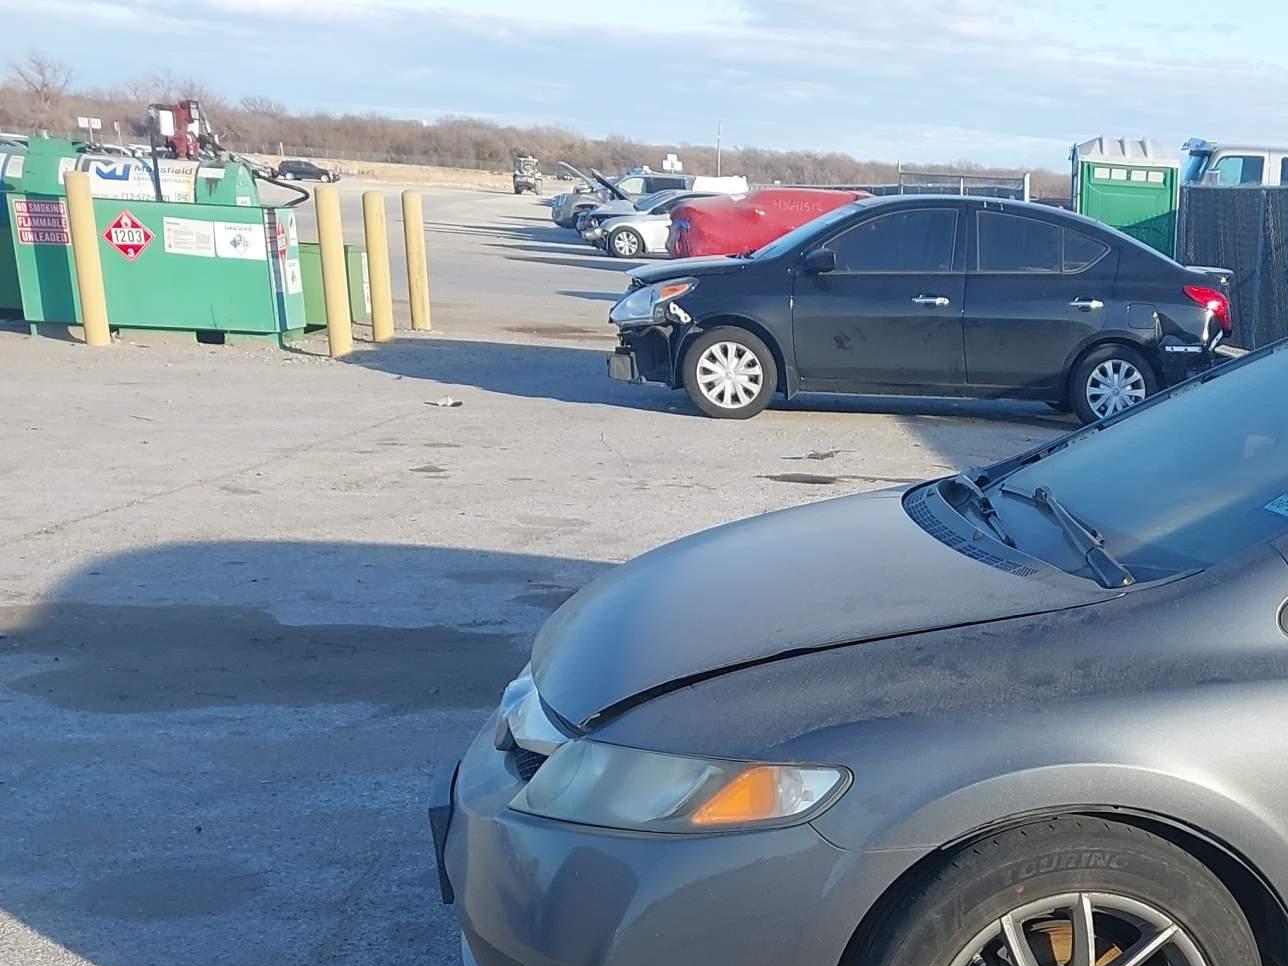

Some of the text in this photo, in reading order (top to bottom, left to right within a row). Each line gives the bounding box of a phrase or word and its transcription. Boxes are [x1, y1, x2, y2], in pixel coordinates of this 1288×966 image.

[15, 201, 64, 214] NO SMOKING
[17, 216, 68, 228] FLAMMABLE
[21, 230, 69, 242] UNLEADED
[114, 229, 142, 243] 1203
[127, 248, 135, 258] 3
[1003, 852, 1129, 886] TOURING
